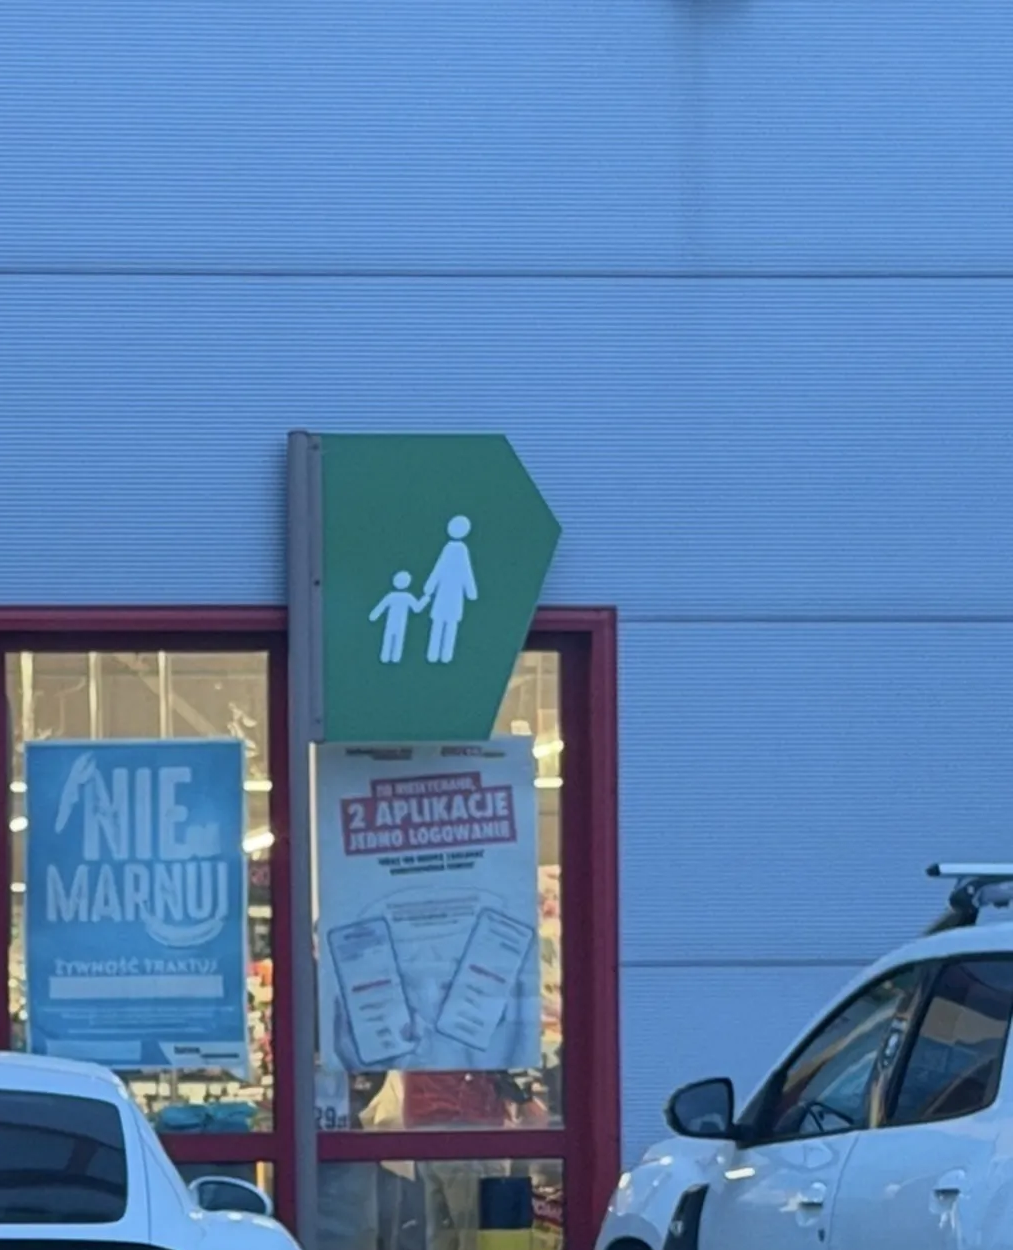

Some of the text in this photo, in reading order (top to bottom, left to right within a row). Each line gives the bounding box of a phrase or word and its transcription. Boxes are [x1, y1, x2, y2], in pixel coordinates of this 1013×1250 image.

[77, 764, 193, 861] NIE
[348, 791, 510, 830] 2 APLIKACJE
[349, 820, 511, 850] JEDNO LOGOWANIE
[47, 861, 228, 922] MARNUJ
[144, 957, 218, 974] TRAKTUJ
